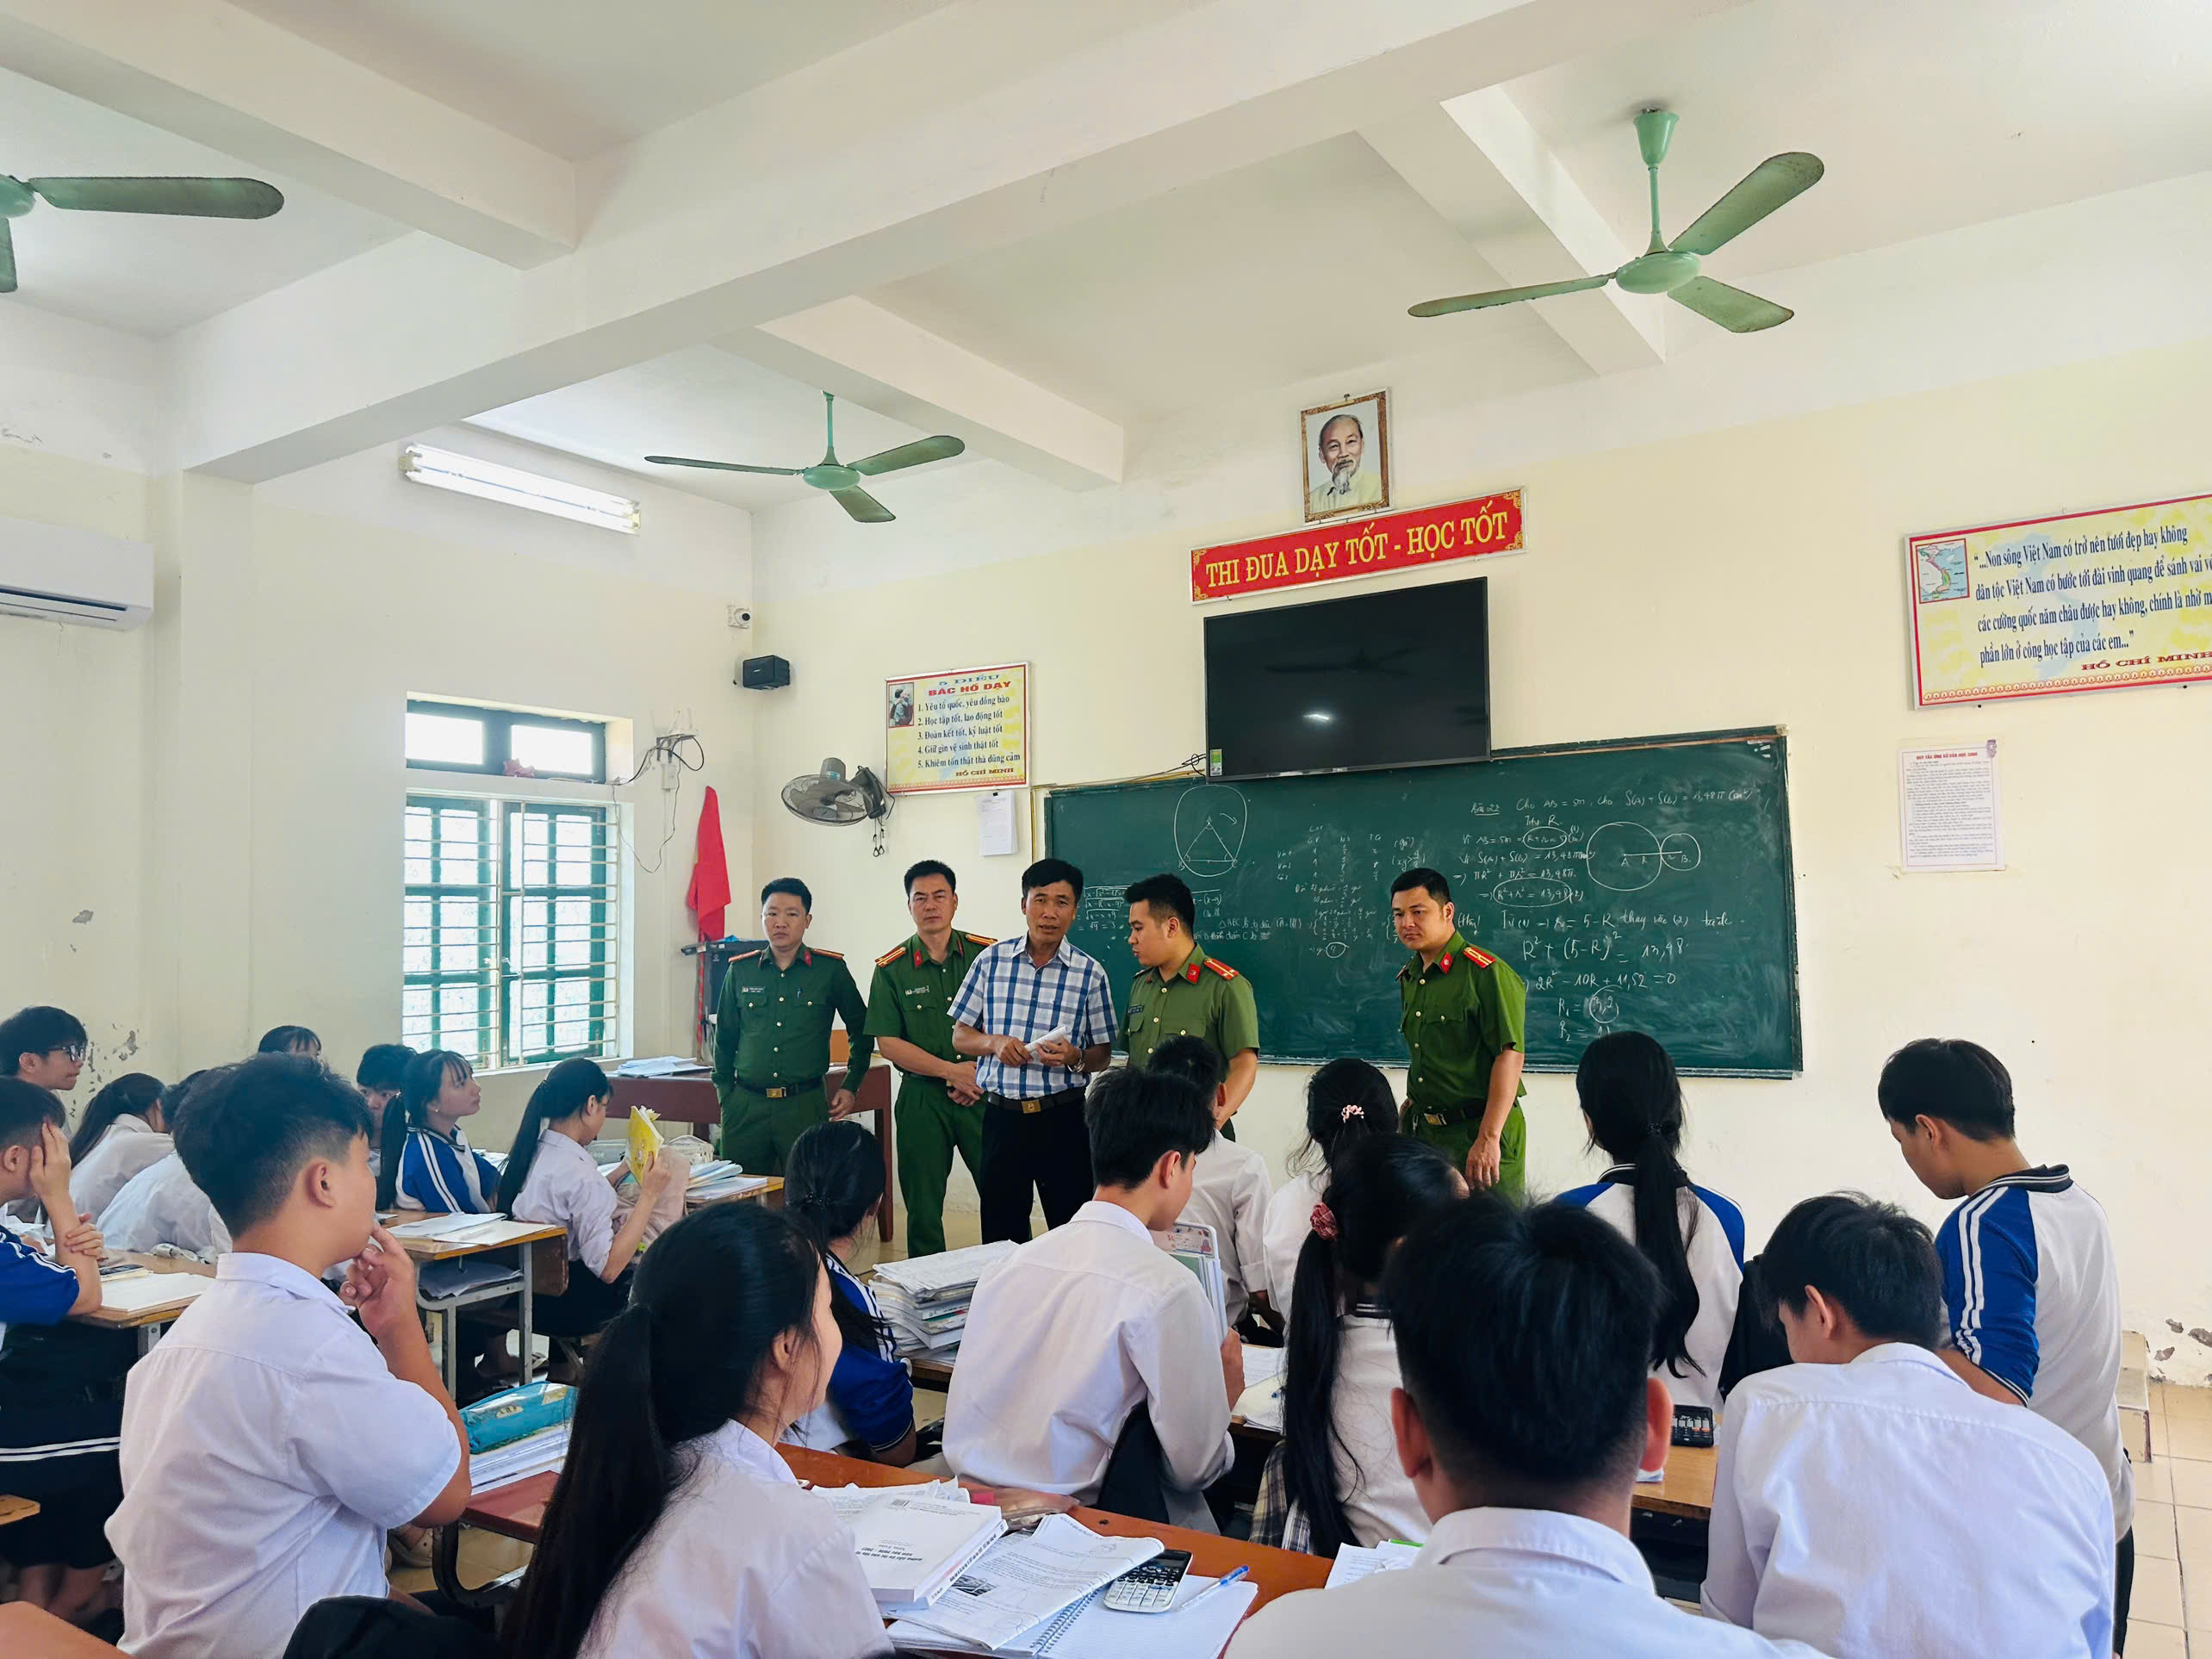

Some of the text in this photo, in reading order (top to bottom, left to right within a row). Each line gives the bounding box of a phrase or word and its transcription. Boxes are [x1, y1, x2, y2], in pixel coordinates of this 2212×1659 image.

[1206, 558, 1240, 587] THI
[1246, 551, 1289, 581] ĐUA
[1295, 543, 1339, 577] DẠY
[1345, 522, 1388, 563] TỐT
[1407, 521, 1455, 558] HỌC
[1461, 500, 1507, 544] TỐT
[2004, 549, 2022, 568] sông
[2023, 544, 2040, 565] Việt
[2042, 542, 2061, 559] Nam
[2063, 538, 2072, 557] có
[2075, 535, 2088, 556] trở
[2090, 536, 2105, 554] nên
[2107, 531, 2123, 550] tươi
[2126, 531, 2141, 552] đẹp
[2143, 527, 2158, 549] hay
[2160, 525, 2188, 545] không
[1976, 581, 1991, 600] dân
[1992, 581, 2004, 601] tộc
[2006, 579, 2023, 600] Việt
[2026, 577, 2044, 594] Nam
[2046, 574, 2055, 592] có
[2058, 570, 2077, 590] bước
[2078, 569, 2090, 587] tới
[2092, 567, 2105, 586] đài
[2107, 565, 2125, 583] vinh
[2128, 565, 2153, 586] quang
[2154, 555, 2165, 578] để
[2166, 556, 2187, 576] sánh
[2189, 554, 2203, 573] vai
[1978, 614, 1991, 632] các
[1993, 612, 2016, 632] cường
[2018, 606, 2037, 631] quốc
[2039, 608, 2057, 625] năm
[2059, 604, 2078, 623] châu
[2080, 601, 2100, 622] được
[2102, 600, 2116, 620] hay
[2118, 596, 2147, 618] không,
[2149, 593, 2173, 612] chính
[2174, 589, 2183, 609] là
[2185, 587, 2202, 607] nhờ
[1980, 642, 2000, 668] phần
[2001, 643, 2015, 662] lớn
[2016, 640, 2022, 660] ở
[2023, 641, 2042, 662] công
[2044, 639, 2059, 660] học
[2060, 637, 2074, 659] tập
[2076, 632, 2091, 653] của
[2092, 632, 2106, 652] các
[2116, 656, 2151, 667] CHÍ
[2157, 650, 2212, 663] MINH
[929, 687, 956, 696] BÁC
[984, 681, 1011, 691] DẠY
[966, 699, 979, 709] yêu
[925, 718, 937, 727] Học
[964, 713, 974, 722] lao
[975, 711, 991, 722] động
[993, 709, 1003, 718] tốt
[924, 730, 941, 740] Đoàn
[943, 727, 954, 738] kết
[993, 723, 1003, 733] tốt
[924, 745, 937, 755] Giữ
[959, 743, 972, 751] sinh
[989, 738, 998, 748] tốt
[925, 759, 947, 767] Khiêm
